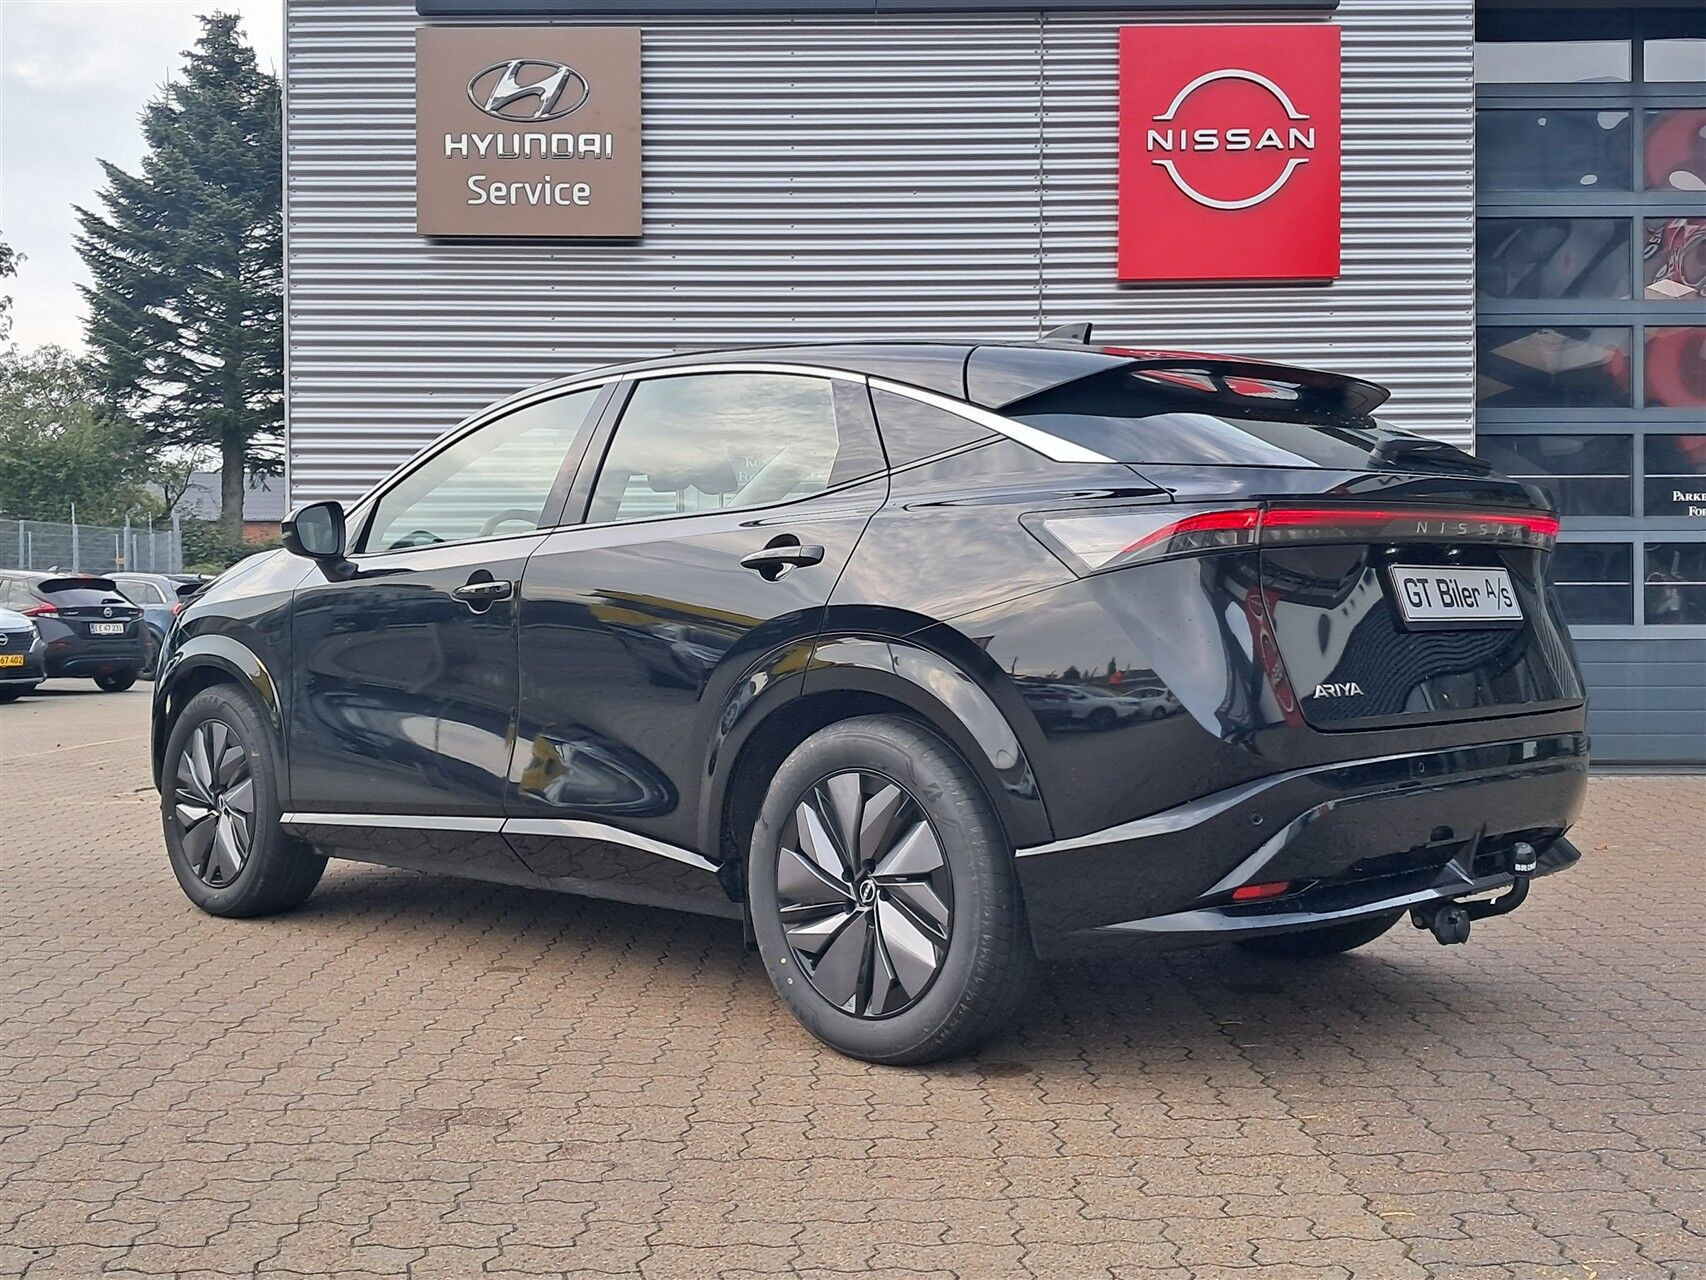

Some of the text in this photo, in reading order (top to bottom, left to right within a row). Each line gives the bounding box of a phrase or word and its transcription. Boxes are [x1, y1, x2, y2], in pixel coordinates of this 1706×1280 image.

[444, 132, 614, 160] HYUNDAI
[1147, 127, 1316, 151] NISSAN
[467, 175, 591, 206] Service
[1404, 577, 1432, 608] GT
[1436, 578, 1480, 608] Biler
[10, 656, 22, 664] 402
[1313, 682, 1364, 699] ARIYA
